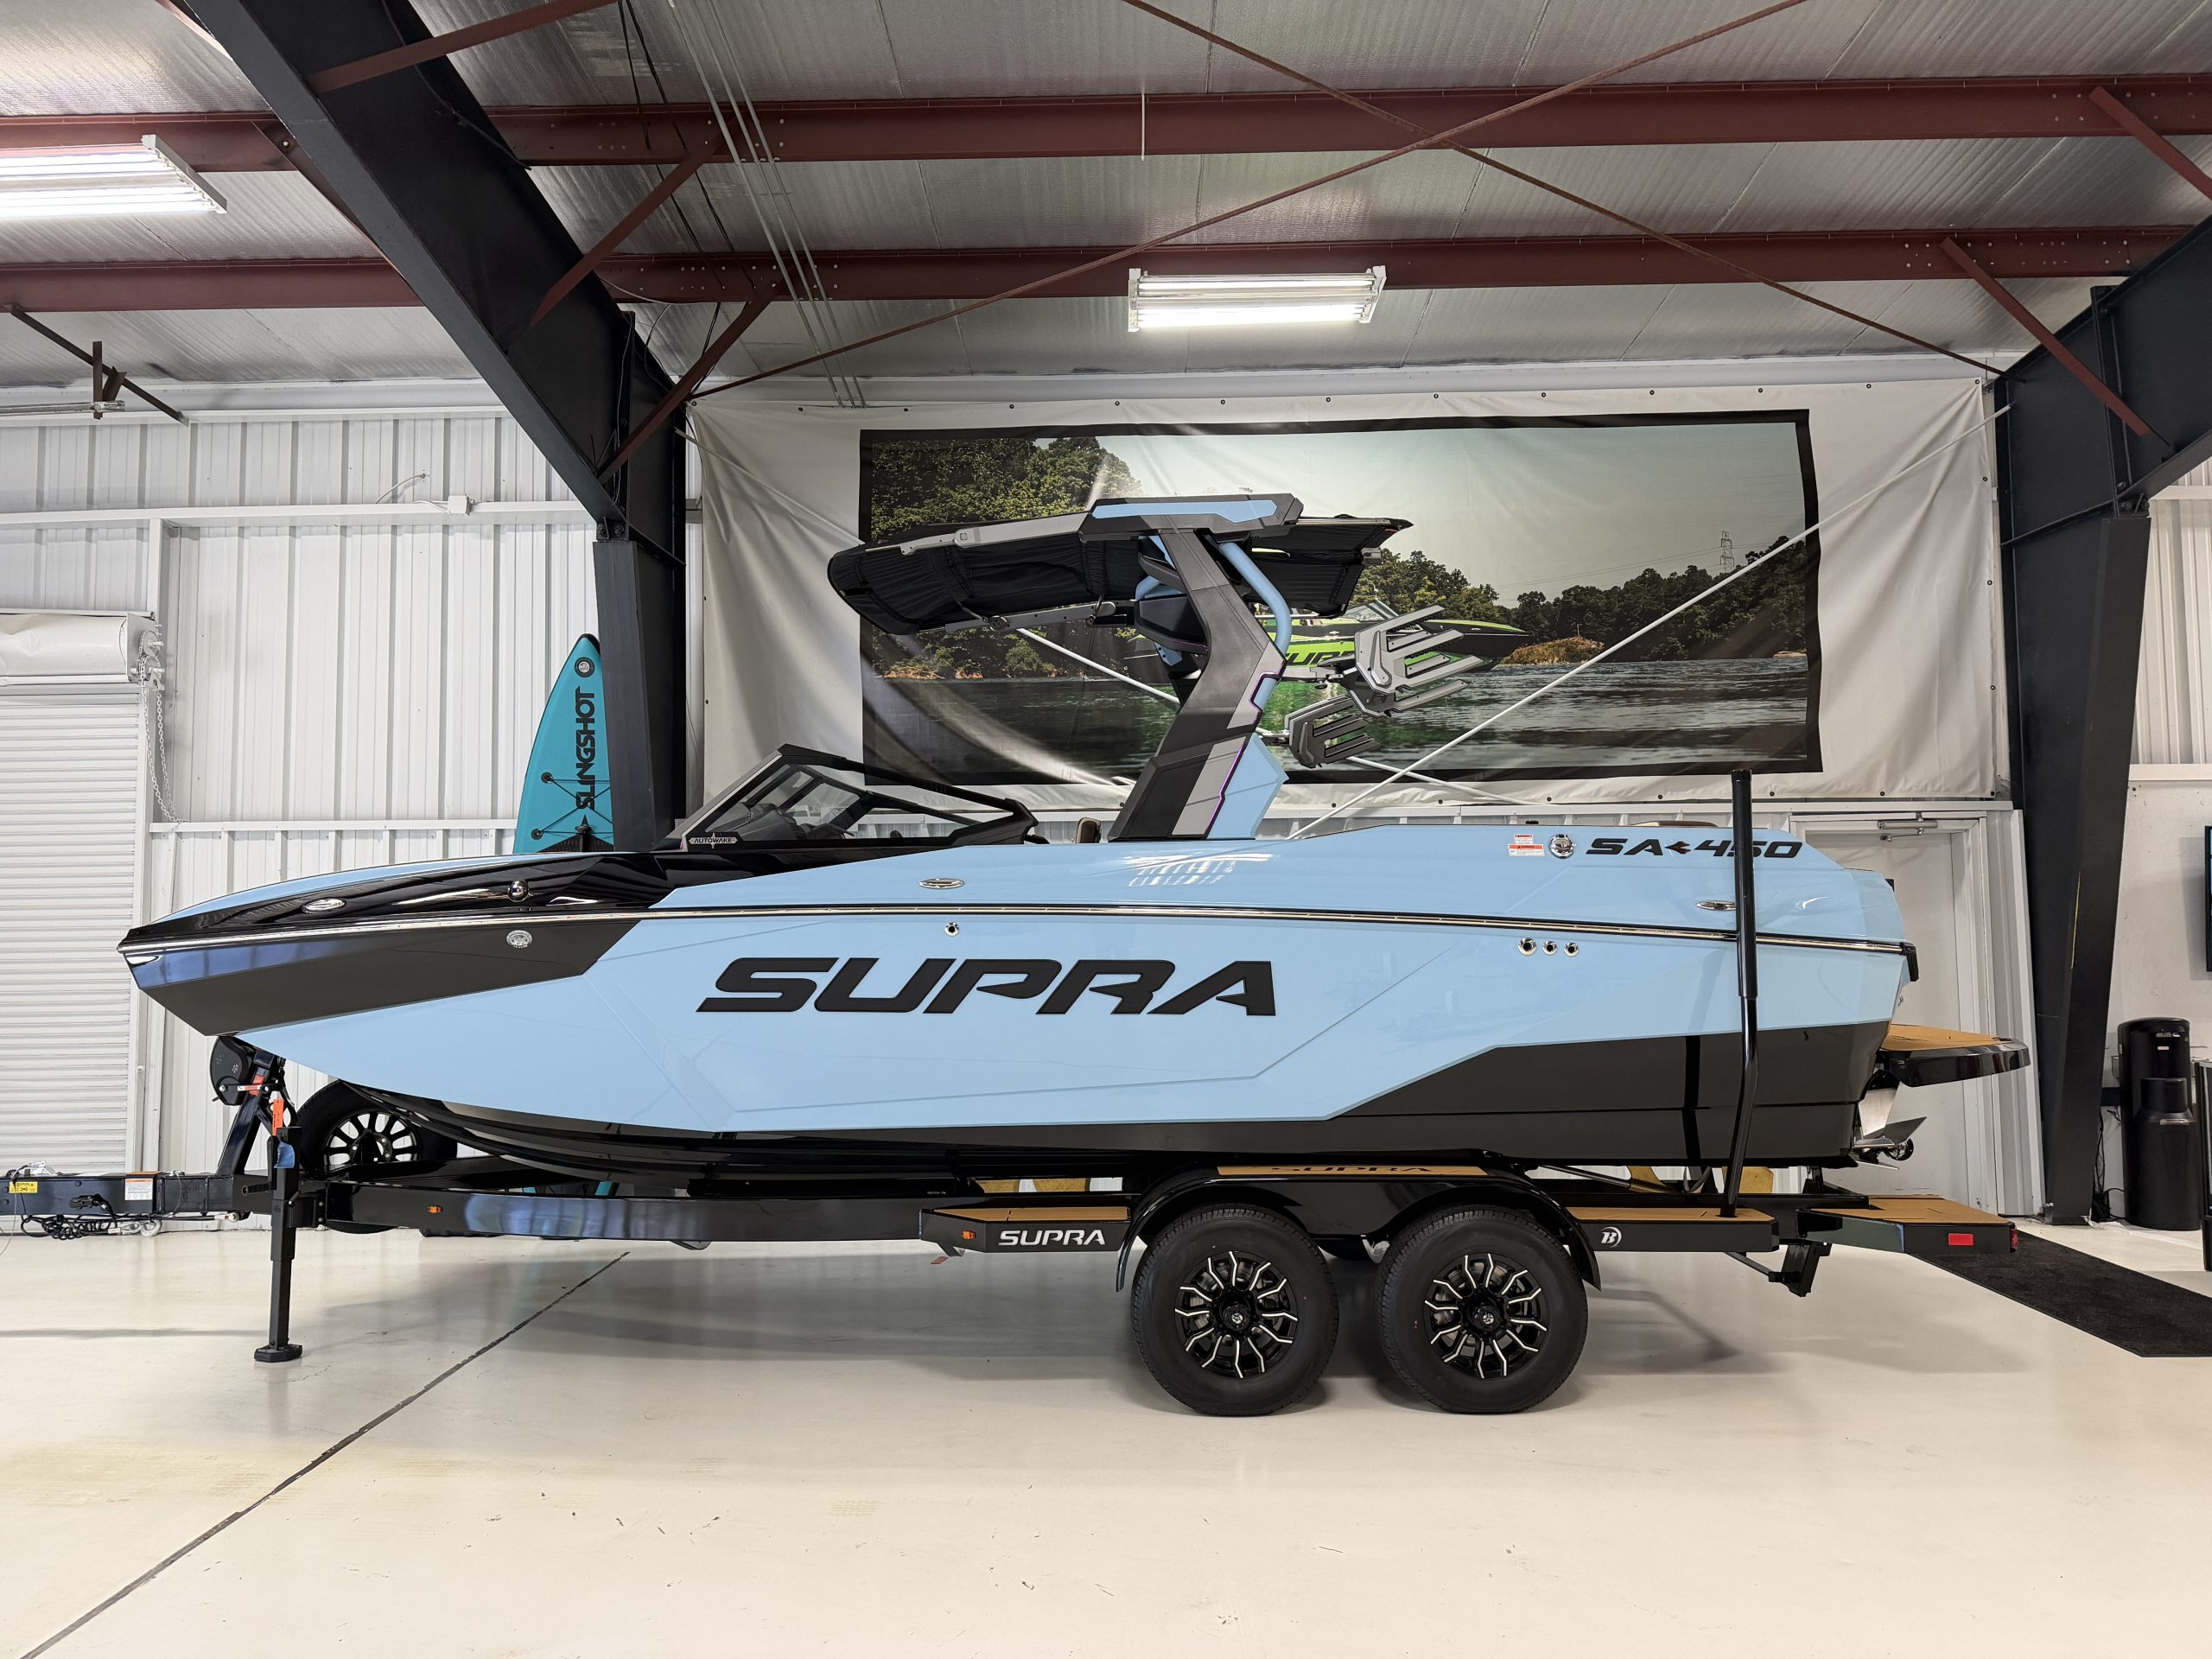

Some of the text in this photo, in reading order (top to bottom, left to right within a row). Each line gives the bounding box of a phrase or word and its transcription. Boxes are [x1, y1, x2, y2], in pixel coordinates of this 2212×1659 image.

[575, 685, 595, 810] SLINGSHOT
[1586, 837, 1663, 856] SA
[696, 957, 1276, 1016] SUPRA
[998, 1230, 1106, 1246] SUPRA
